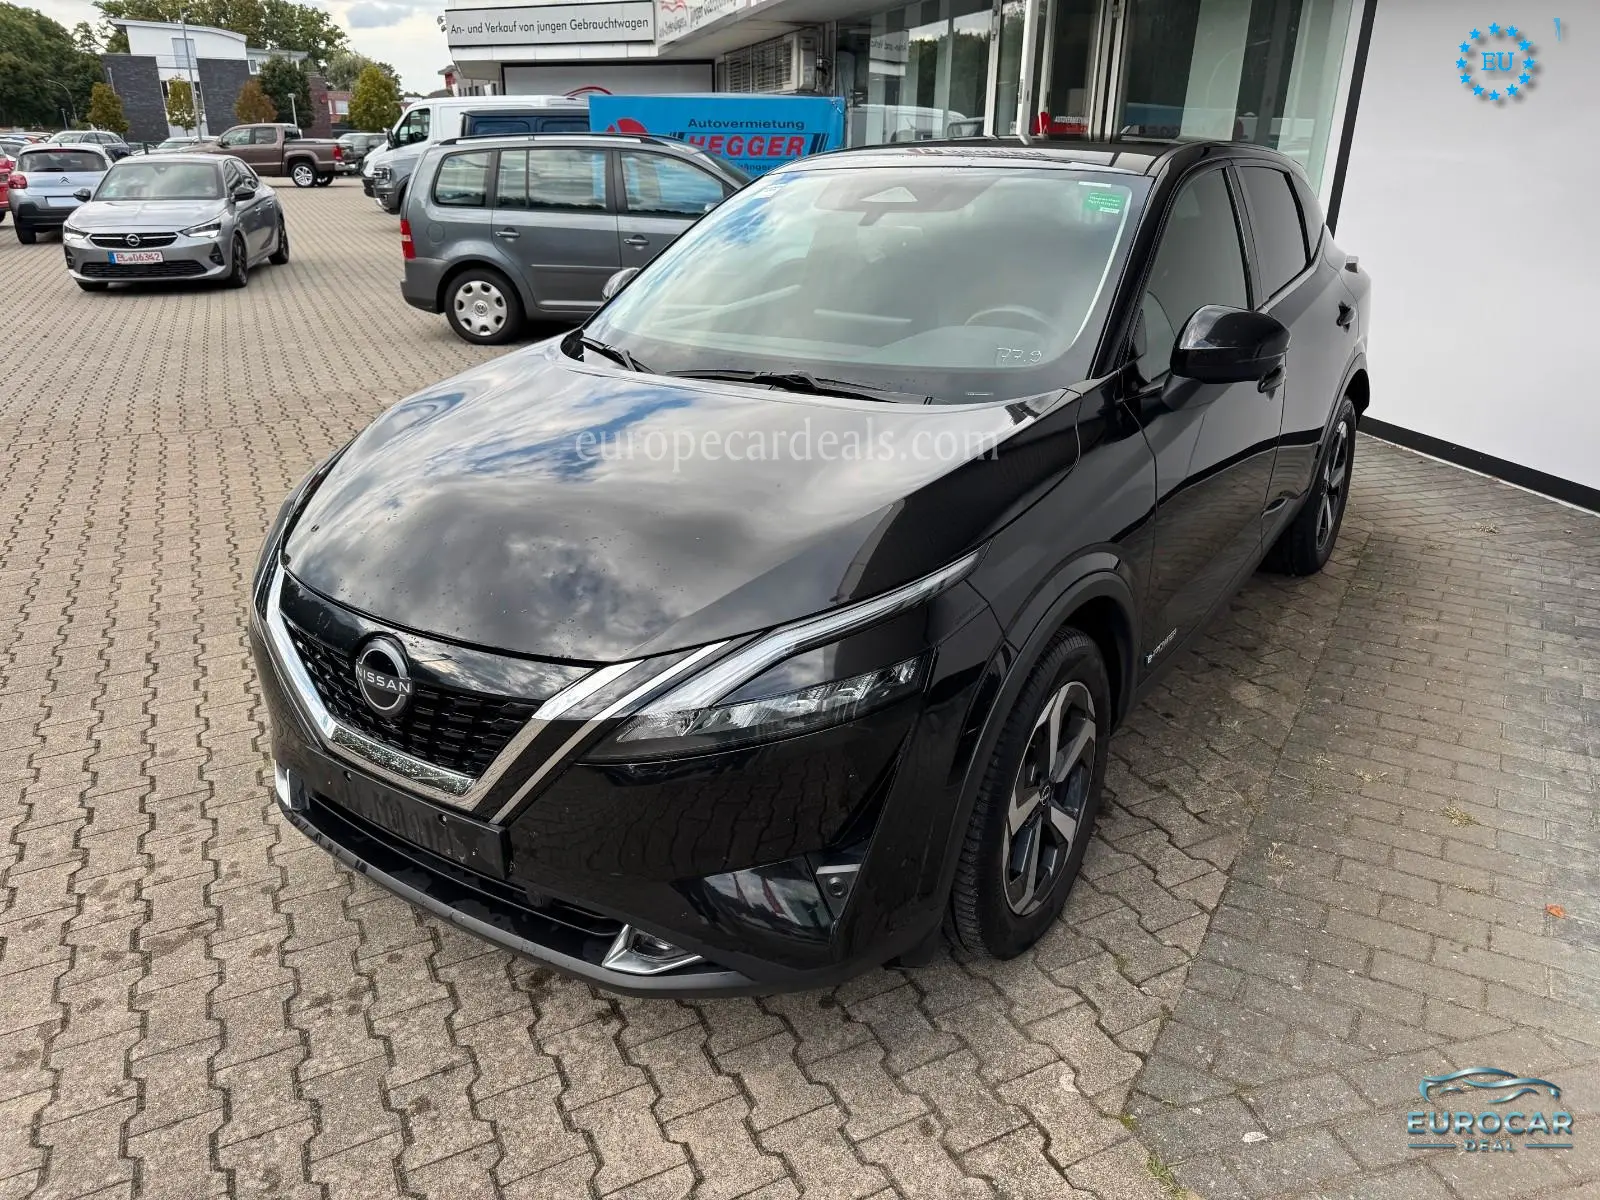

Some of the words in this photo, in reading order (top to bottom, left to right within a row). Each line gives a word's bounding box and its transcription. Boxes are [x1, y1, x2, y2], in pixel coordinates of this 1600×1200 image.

[451, 24, 465, 34] An-
[467, 22, 483, 33] und
[484, 20, 517, 33] Verkauf
[518, 23, 535, 32] von
[536, 20, 567, 33] jungen
[569, 16, 649, 31] Gebrauchtwagen
[687, 118, 805, 131] Autovermietung
[688, 135, 806, 157] HEGGER
[355, 664, 410, 693] NISSAN
